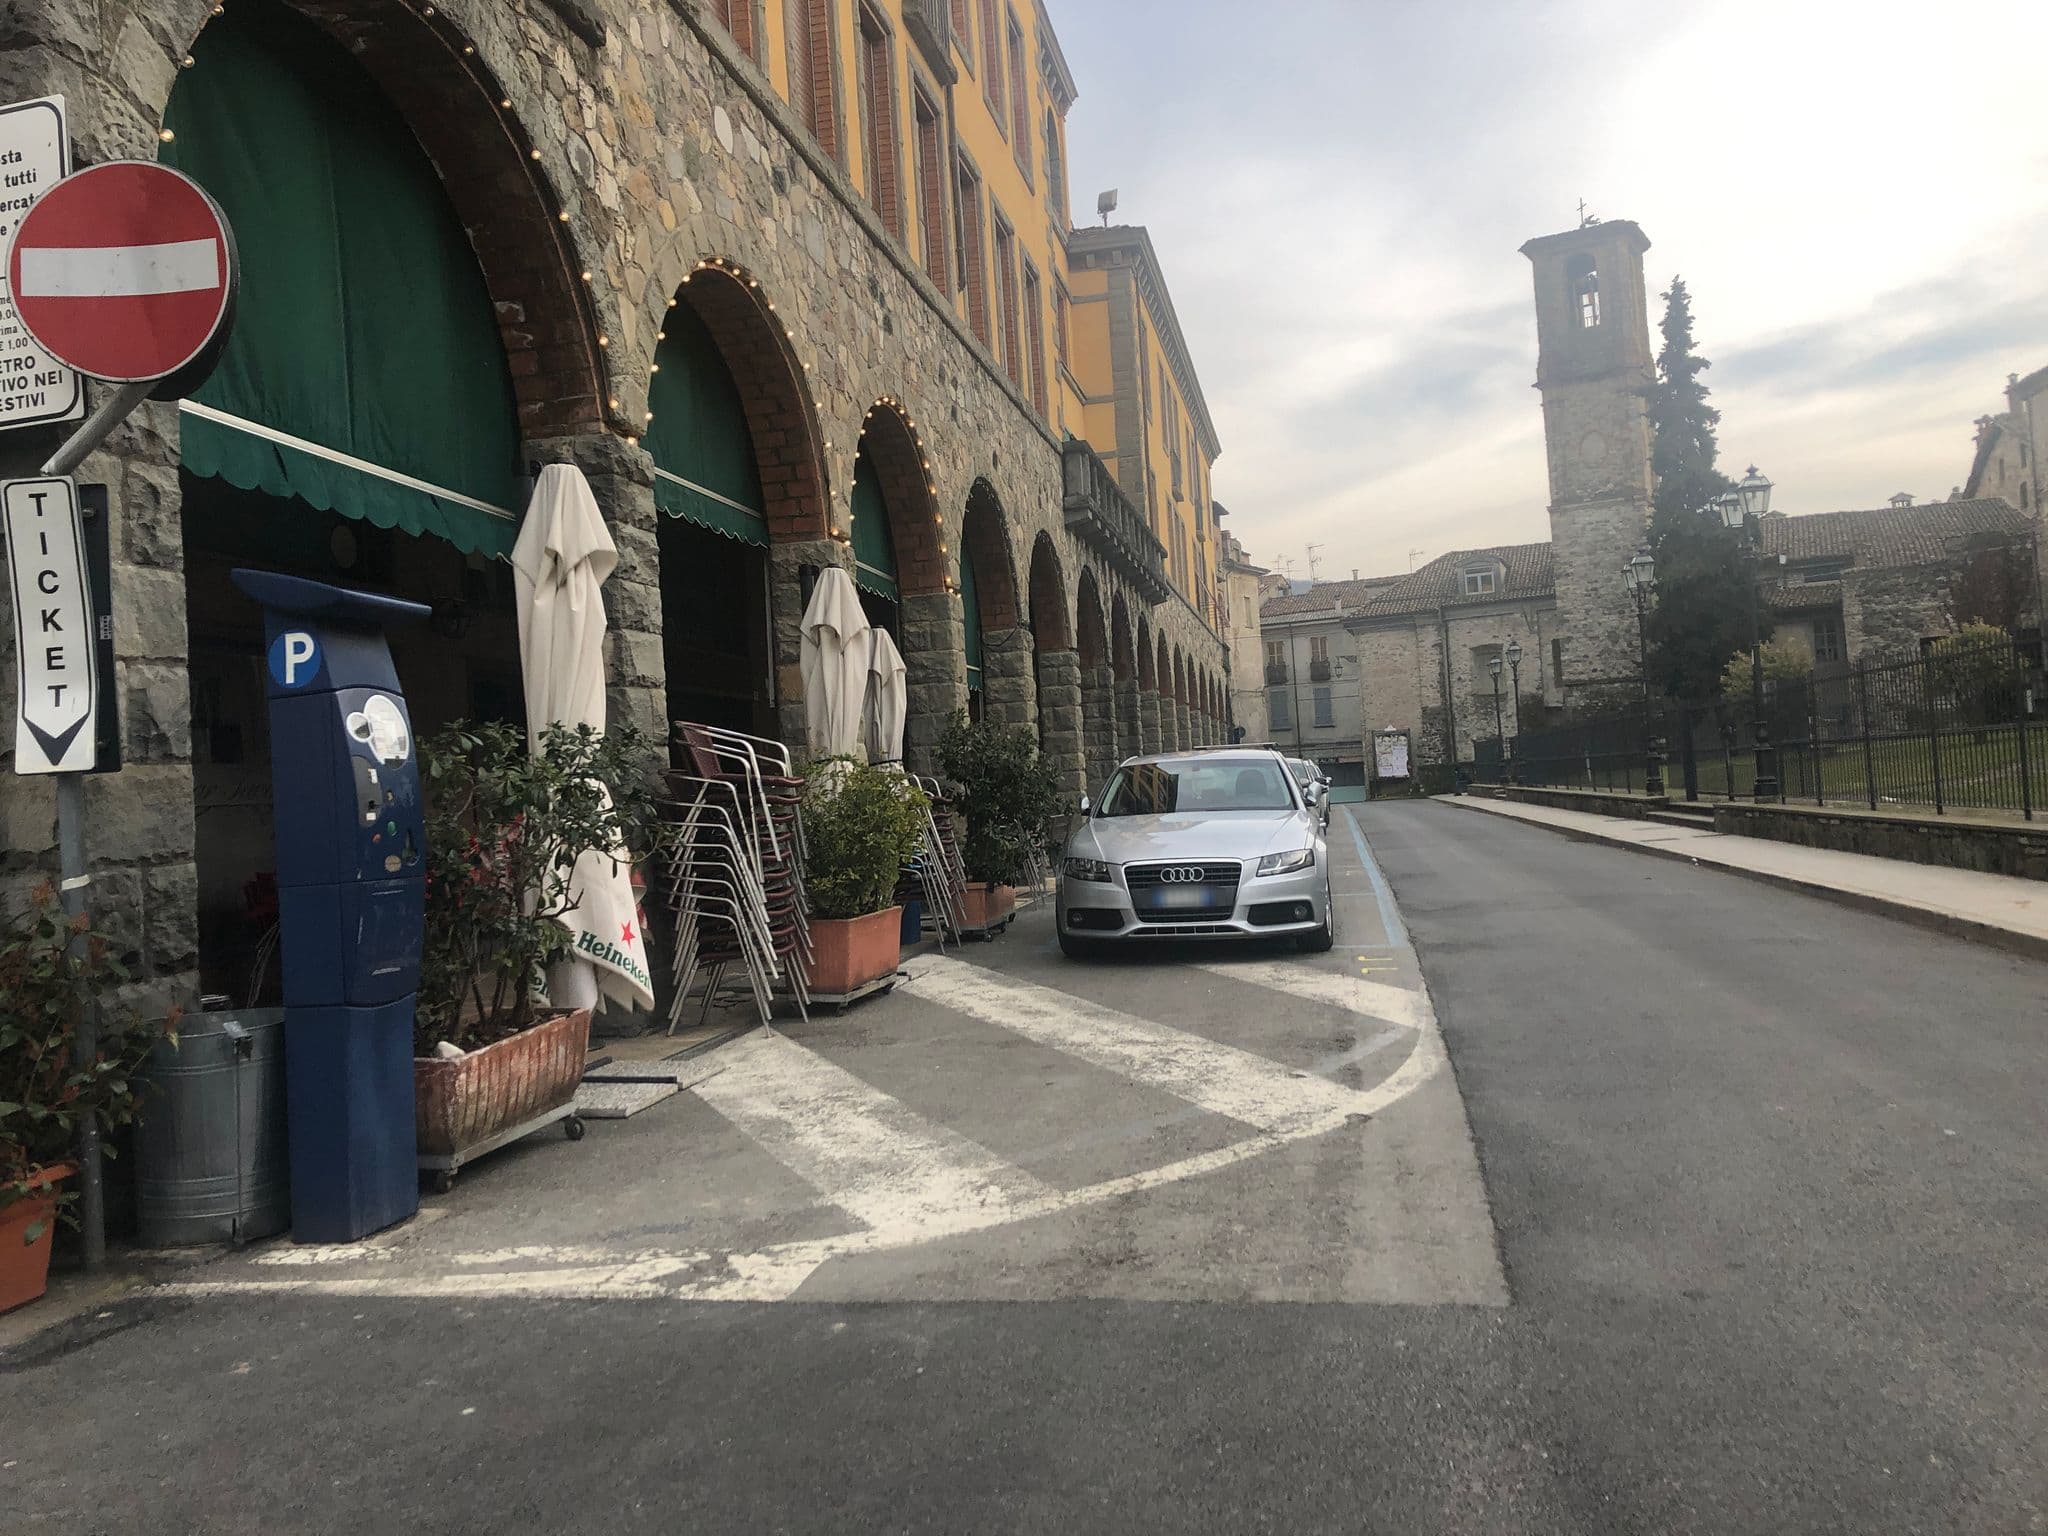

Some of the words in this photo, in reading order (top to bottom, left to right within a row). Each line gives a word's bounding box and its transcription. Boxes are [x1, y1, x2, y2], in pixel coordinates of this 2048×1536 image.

[0, 150, 22, 165] sta
[5, 168, 36, 188] tutti
[0, 193, 35, 212] ercat
[0, 325, 17, 336] ima
[0, 376, 28, 392] IVO
[35, 370, 63, 387] NEI
[29, 492, 67, 707] TICKET
[284, 632, 315, 684] P
[577, 930, 651, 990] Heineken
